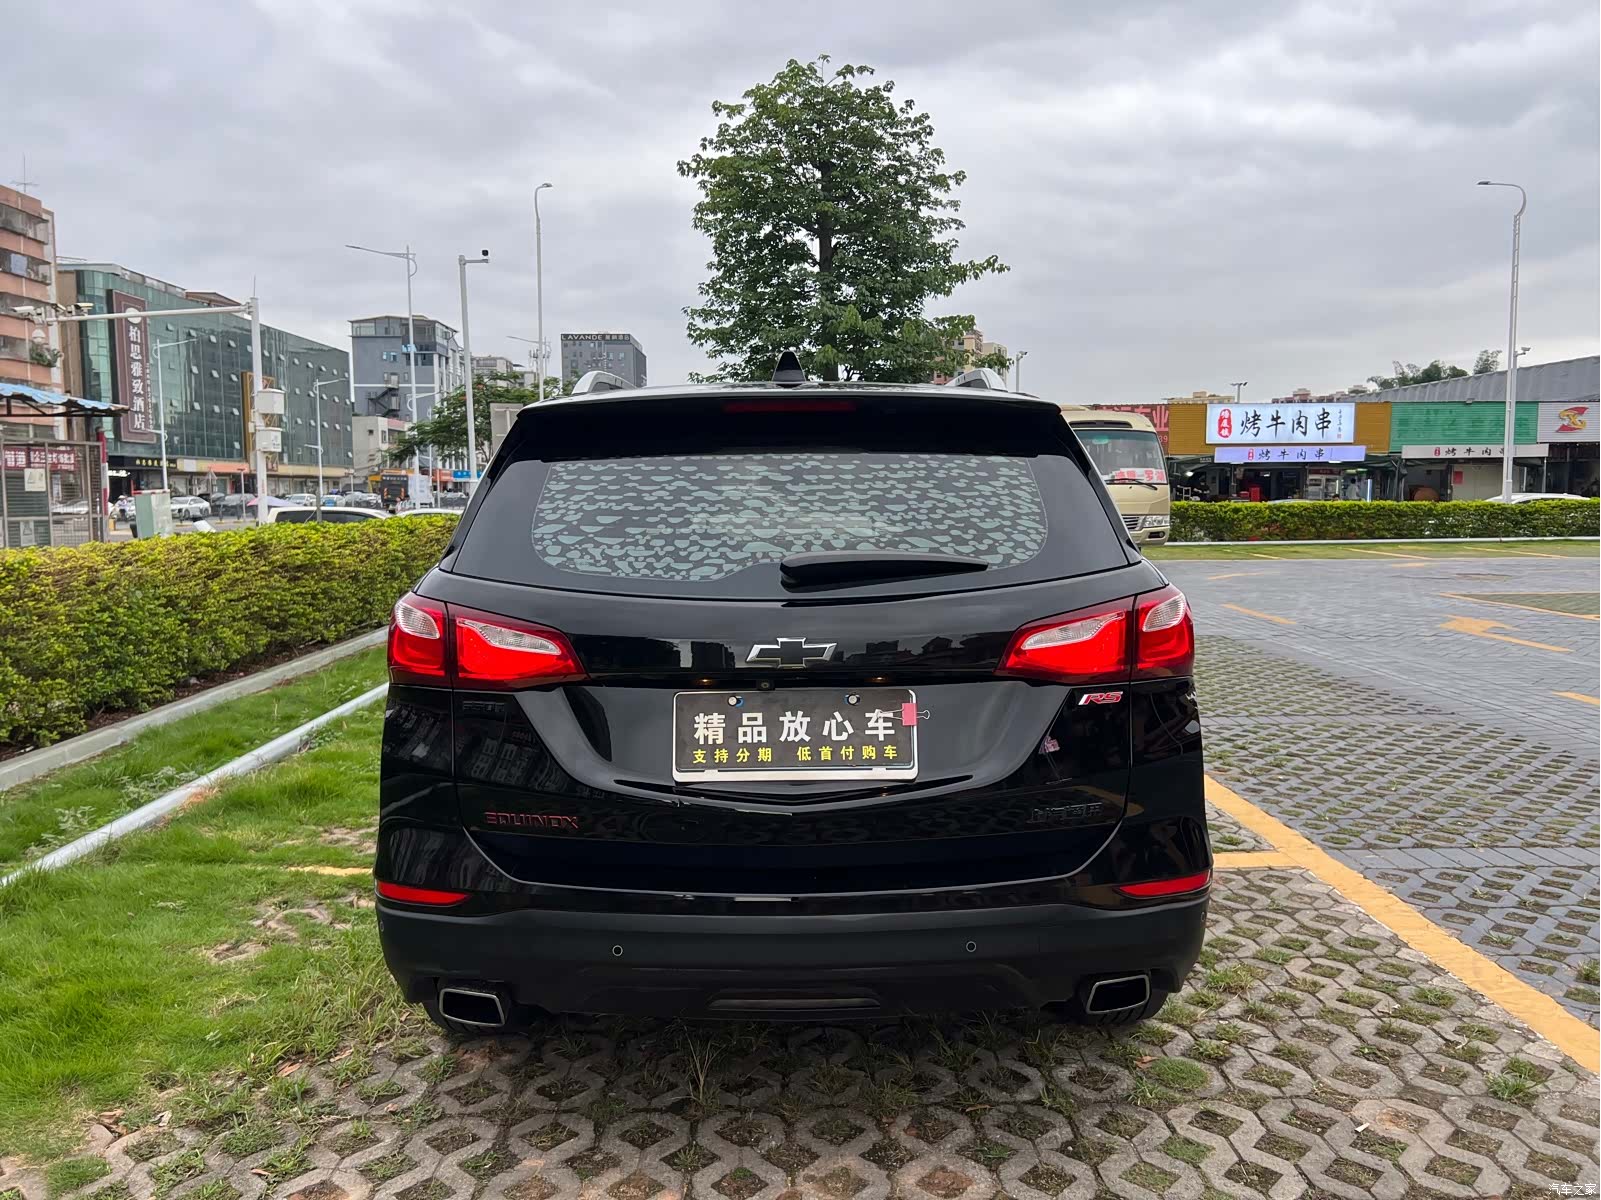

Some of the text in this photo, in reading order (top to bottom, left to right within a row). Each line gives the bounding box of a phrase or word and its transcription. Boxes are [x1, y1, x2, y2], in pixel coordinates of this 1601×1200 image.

[128, 325, 146, 431] 柏思雅致酒店
[1239, 407, 1332, 439] 烤牛肉串
[1258, 448, 1325, 461] 烤牛肉串
[1080, 691, 1124, 705] RS
[693, 709, 896, 744] 精品放心车
[692, 745, 898, 763] 支持分期 低首付购车
[484, 812, 579, 828] EQUINOX
